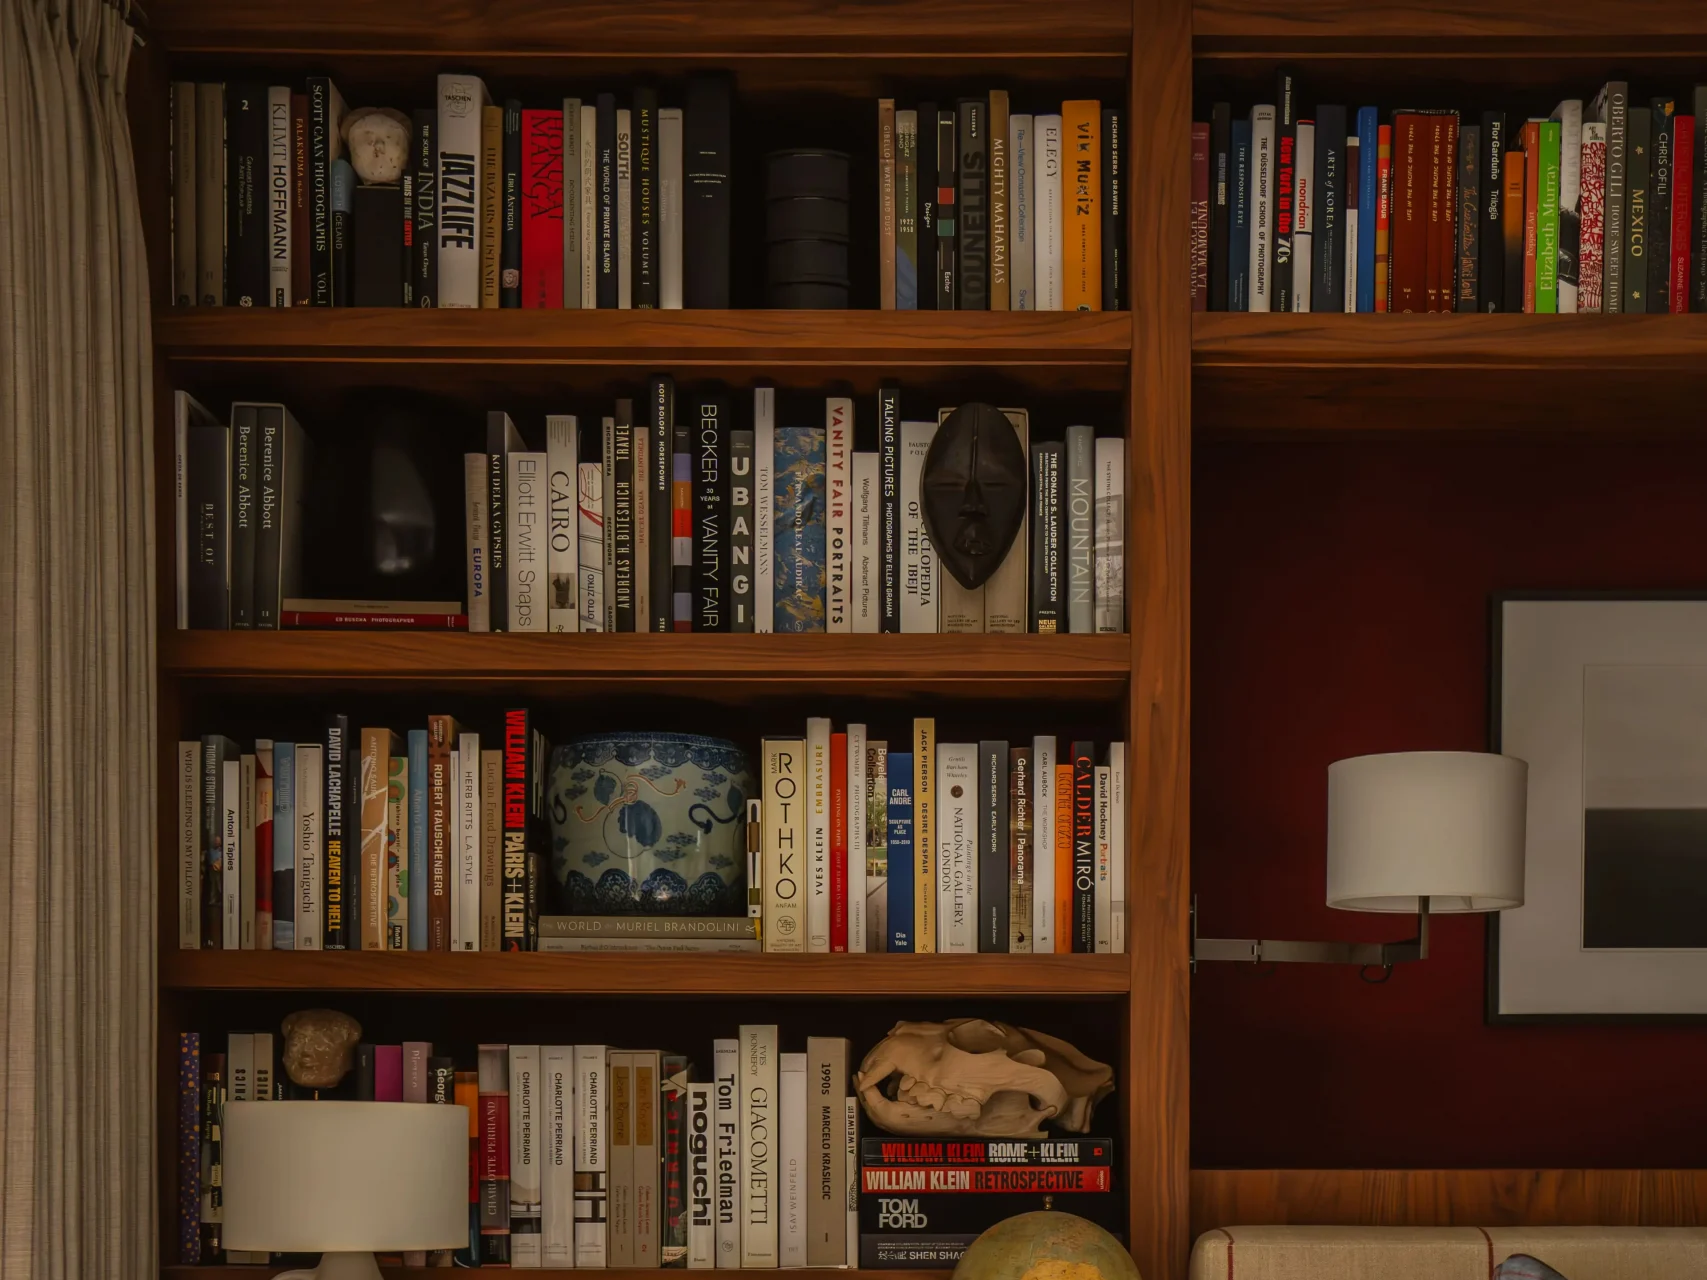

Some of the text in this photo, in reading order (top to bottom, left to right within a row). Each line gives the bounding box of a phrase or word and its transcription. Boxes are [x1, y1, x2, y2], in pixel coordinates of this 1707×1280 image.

[241, 100, 249, 111] 2
[272, 103, 287, 160] KLIMT
[312, 85, 323, 123] SCOTT
[313, 126, 324, 157] CAAN
[440, 151, 475, 249] JAZZ LIFE
[523, 115, 550, 219] MANGA
[603, 165, 611, 192] WORLD
[603, 194, 611, 204] OF
[618, 132, 629, 180] SOUTH
[1046, 128, 1057, 179] ELEGY
[1490, 122, 1500, 220] Flor Garduño Trilogía
[1657, 132, 1669, 195] CHRIS OFILI
[273, 165, 287, 259] HOFFMANN
[314, 161, 326, 251] PHOTOGRAPHS
[603, 206, 611, 238] PRIVATE
[994, 138, 1006, 284] MIGHTY MAHARAJAS
[1257, 137, 1269, 295] THE DÜSSELDORF SCHOOL OF PHOTOGRAPHY
[1298, 178, 1309, 228] mondrian
[1541, 163, 1558, 290] Elizabeth Murray
[1608, 93, 1624, 313] OBERTO GILI HOME SWEET HOME
[1631, 189, 1645, 257] MEXICO
[603, 240, 611, 273] ISLANDS
[944, 271, 952, 292] Escher
[239, 426, 250, 528] Berenice Abbott
[263, 427, 275, 529] Berenice Abbott
[616, 424, 630, 460] TRAVEL
[701, 404, 718, 482] BECKER
[516, 460, 536, 626] Elliott Erwitt Snaps
[550, 470, 570, 552] CAIRO
[617, 482, 630, 608] ANDREAS H. BITESNICH
[731, 456, 750, 623] UBANGI
[832, 407, 843, 624] VANITY FAIR PORTRAITS
[861, 478, 870, 617] Wolfgang Tillmans Abstract Pictures
[884, 398, 894, 617] TALKING PICTURES PHOTOGRAPHS BY ELLEN GRAHAM
[905, 501, 919, 595] OF THE IBEJI
[1072, 478, 1089, 603] MOUNTAIN
[473, 548, 483, 597] EUROPA
[702, 515, 719, 626] VANITY FAIR
[206, 744, 216, 803] THOMAS STRUTH
[892, 789, 909, 797] CARL
[300, 812, 315, 913] Yoshio Taniguchi
[328, 728, 341, 932] DAVID LACHAPELLE HEAVEN TO HELL
[434, 764, 443, 896] ROBERT RAUSCHENBERG
[485, 762, 497, 887] Lucian Freud Drawings
[504, 710, 525, 937] WILLIAM KLEIN PARIS+KLEIN
[776, 753, 797, 899] ROTHKO
[941, 842, 951, 892] LONDON
[952, 807, 963, 927] NATIONAL GALLERY,
[1076, 756, 1095, 890] CALDER MIRÓ
[556, 921, 739, 932] WORLD MURIEL BRANDOLINI
[750, 1033, 758, 1076] BONNEFOY
[759, 1045, 767, 1065] YVES
[689, 1091, 711, 1225] noguchi
[719, 1074, 736, 1223] Tom Friedman
[750, 1087, 767, 1224] GIACOMETTI
[821, 1063, 831, 1200] 1990s MARCELO KRASILCIC
[881, 1143, 1079, 1163] WILLIAM KLEIN ROME+KLEIN
[866, 1171, 1083, 1190] WILLIAM KLEIN RETROSPECTIVE
[878, 1199, 919, 1214] TOM
[878, 1213, 928, 1229] FORD
[909, 1251, 937, 1260] SHEN
